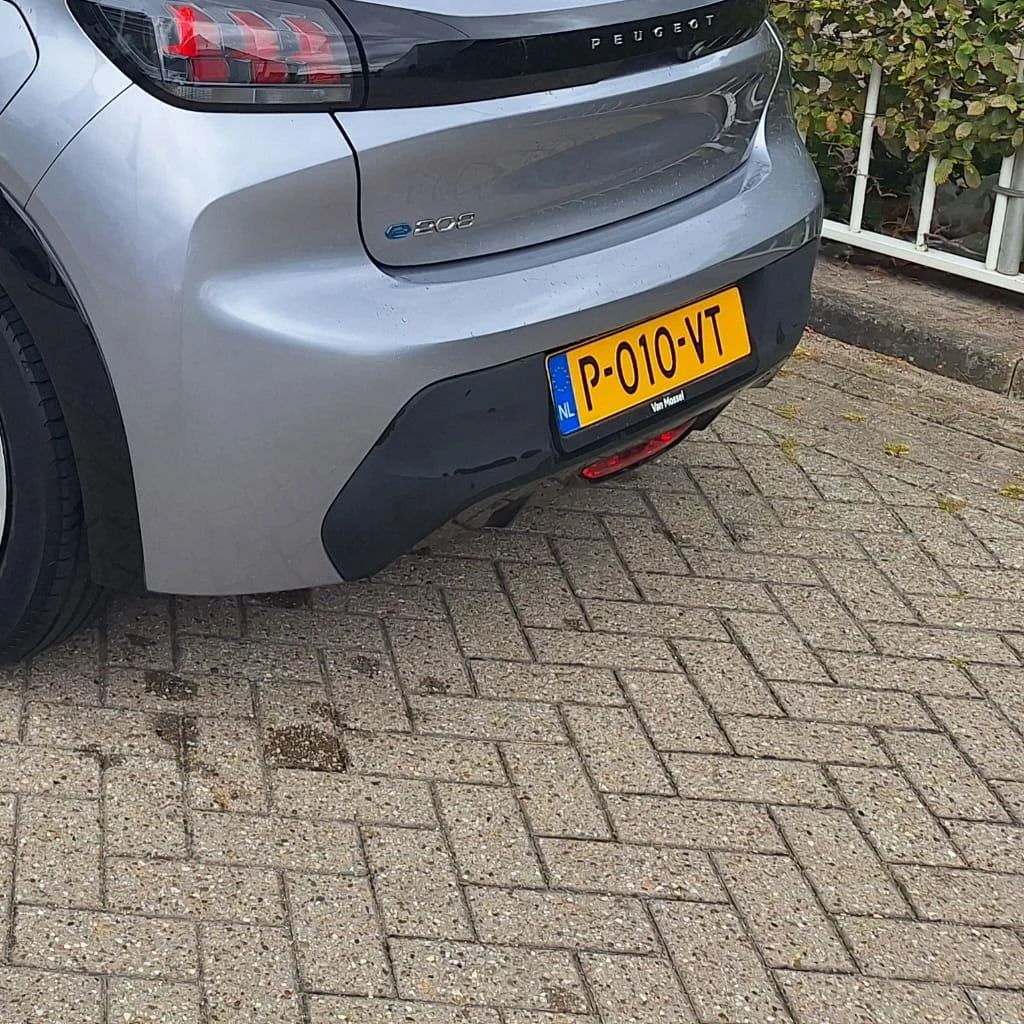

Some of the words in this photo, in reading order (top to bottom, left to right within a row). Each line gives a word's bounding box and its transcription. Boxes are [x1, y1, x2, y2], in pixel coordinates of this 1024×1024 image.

[590, 14, 715, 50] PEUGEOT
[577, 304, 724, 412] P-010-VT
[557, 401, 576, 421] NL
[650, 400, 665, 413] Van
[662, 389, 685, 409] Mossel
